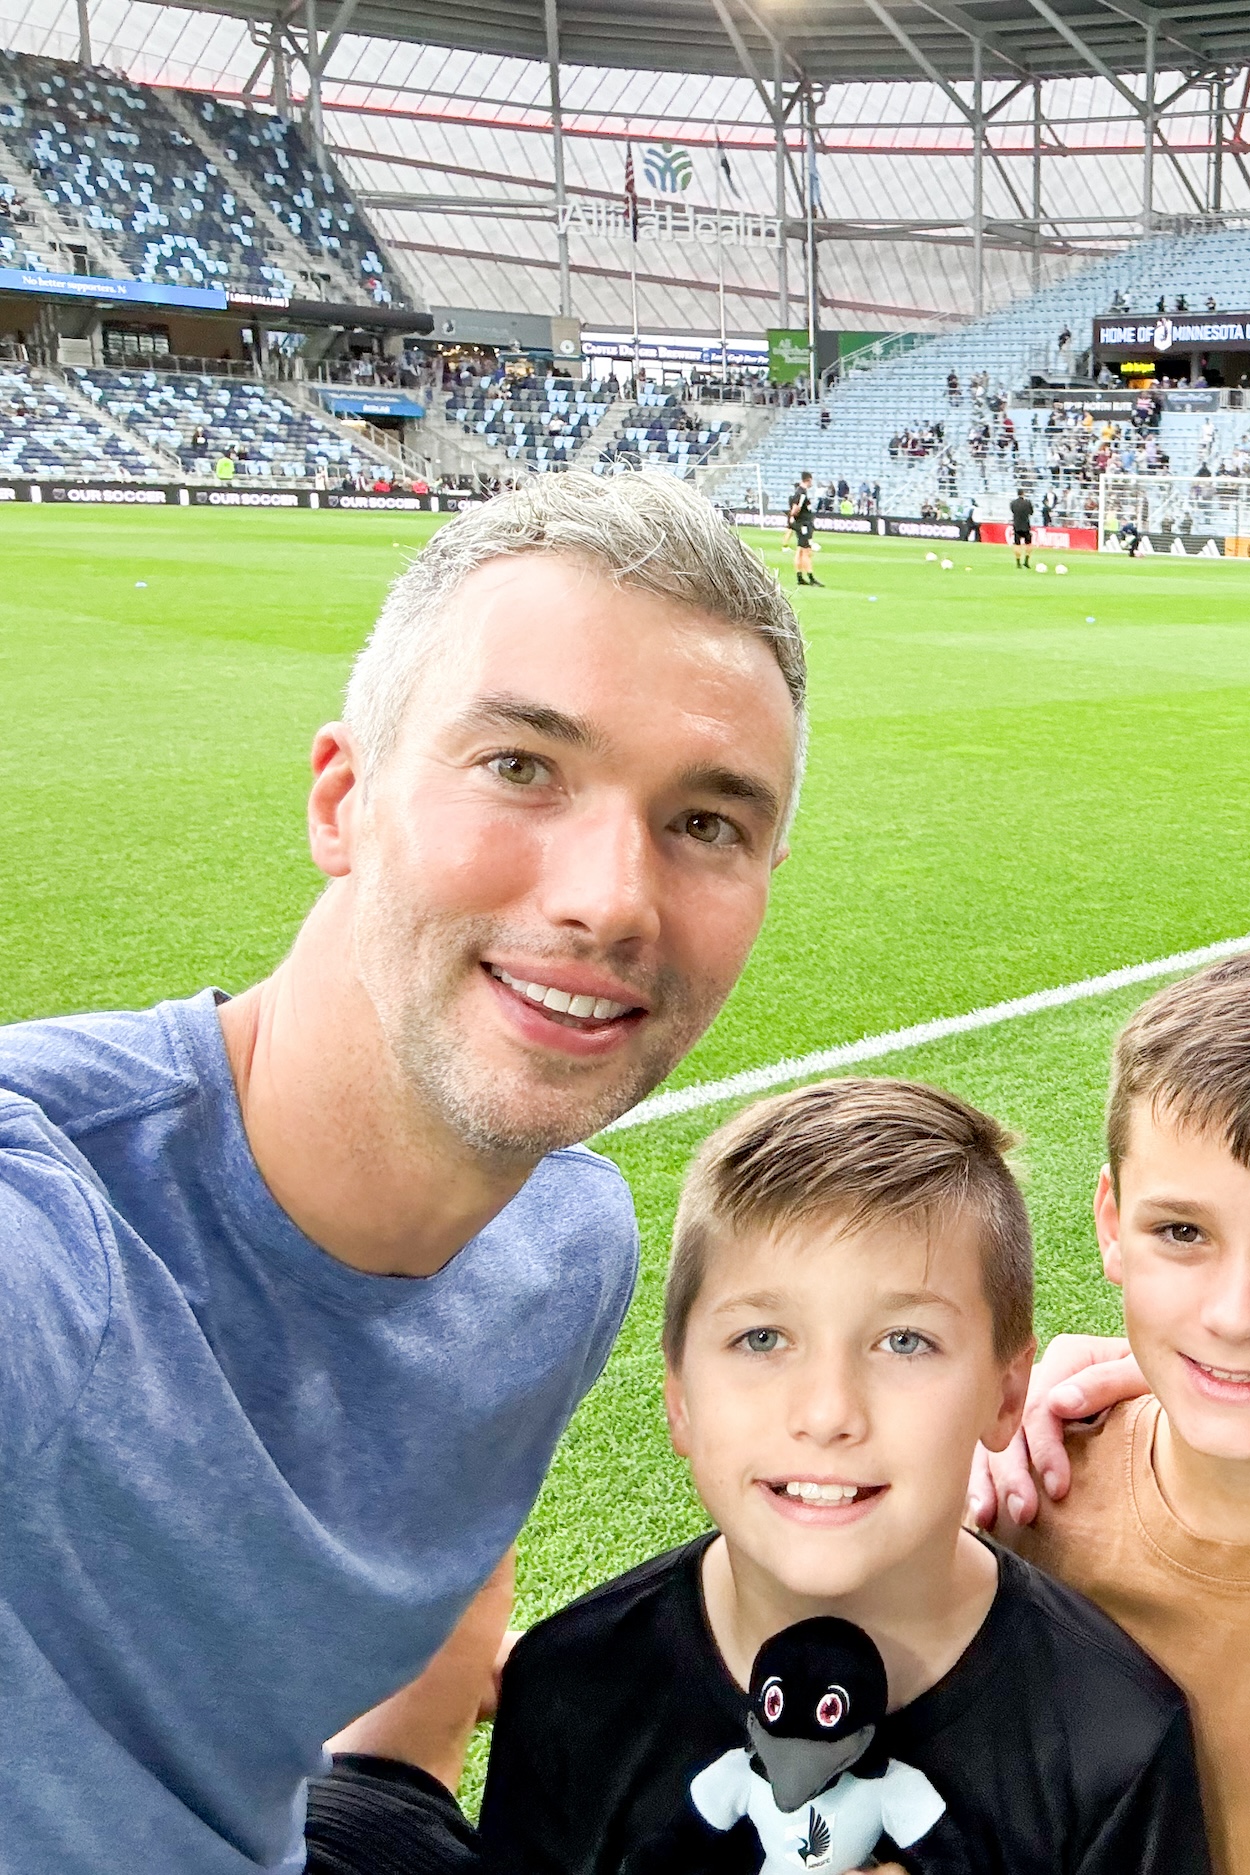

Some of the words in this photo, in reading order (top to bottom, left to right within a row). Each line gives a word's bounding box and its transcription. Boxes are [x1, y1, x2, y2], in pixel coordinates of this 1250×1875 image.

[22, 275, 37, 286] No
[38, 277, 67, 289] better
[67, 281, 116, 293] supporters.
[1100, 327, 1136, 344] HOME
[1137, 326, 1154, 343] OF
[1172, 324, 1245, 342] MINNESOTA
[67, 488, 102, 501] OUR
[103, 489, 166, 503] SOCCER
[209, 492, 240, 504] OUR
[241, 493, 298, 506] SOCCER
[340, 496, 368, 508] OUR
[368, 497, 420, 509] SOCCER
[814, 517, 833, 530] OUR
[833, 519, 871, 533] SOCCER
[899, 523, 919, 535] OUR
[919, 524, 960, 538] SOCCER
